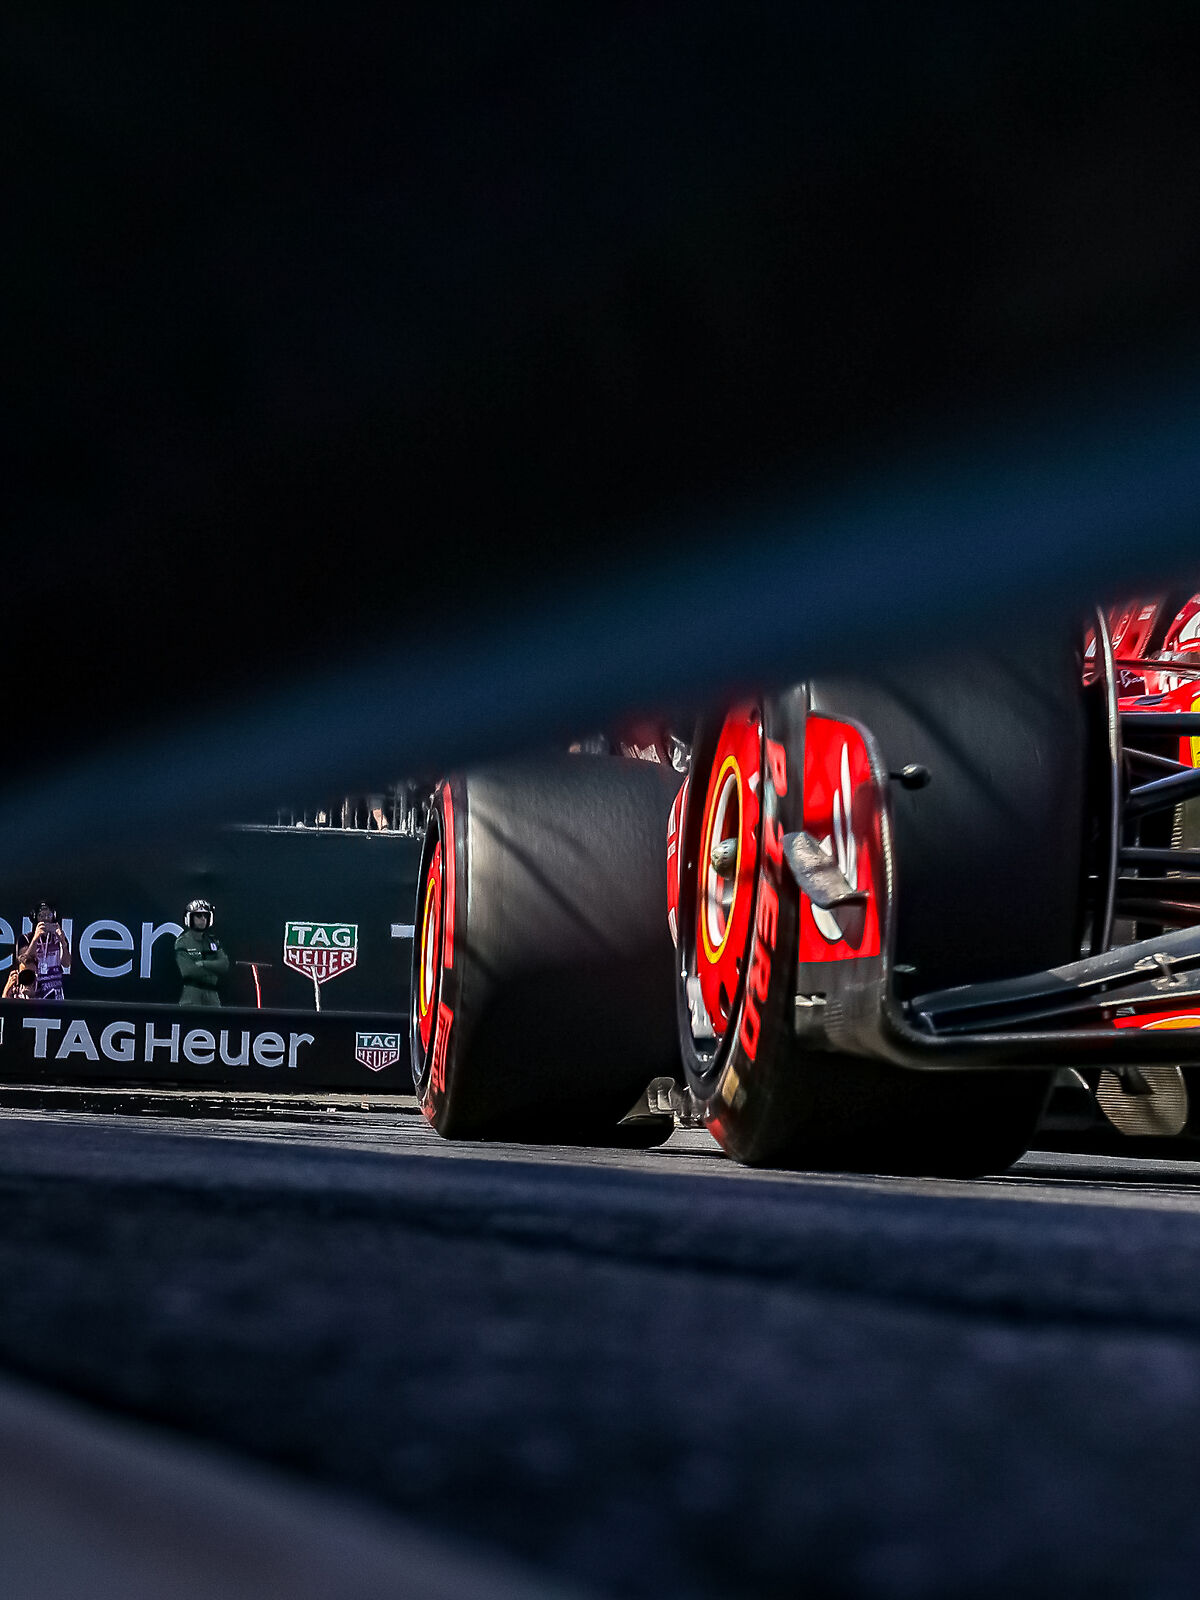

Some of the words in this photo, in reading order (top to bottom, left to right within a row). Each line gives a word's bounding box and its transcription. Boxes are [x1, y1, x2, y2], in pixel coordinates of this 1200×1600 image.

[291, 925, 352, 947] TAG
[0, 916, 185, 980] uer
[288, 949, 353, 979] HEUER
[359, 1035, 397, 1048] TAG
[357, 1049, 397, 1069] HEUER
